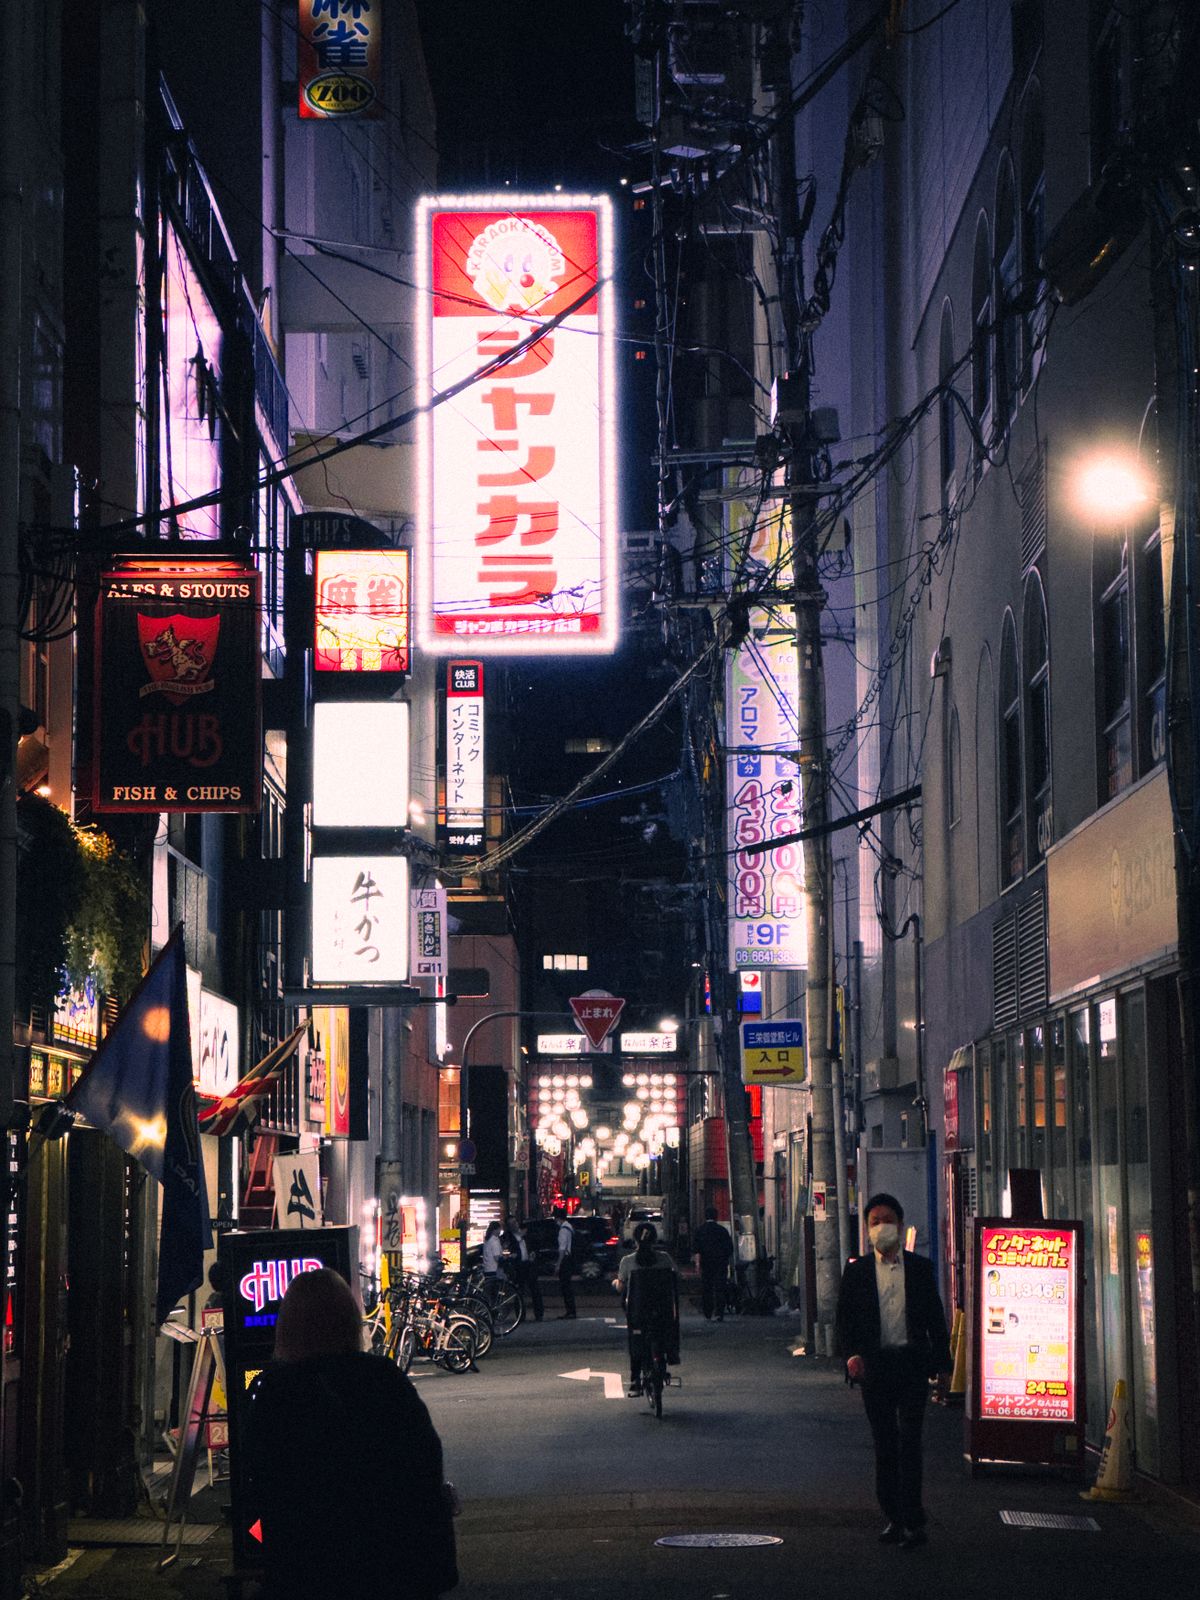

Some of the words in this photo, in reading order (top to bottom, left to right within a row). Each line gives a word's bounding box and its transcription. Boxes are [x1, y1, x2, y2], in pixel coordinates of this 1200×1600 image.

[471, 221, 529, 271] KARAOKE
[475, 324, 559, 607] ジャンカラ
[106, 583, 156, 599] ALES
[159, 583, 175, 599] &
[179, 583, 251, 599] STOUTS
[454, 669, 476, 680] 快活
[454, 680, 476, 689] CLUB
[740, 687, 758, 741] アロマ
[127, 712, 223, 768] HUB
[468, 704, 480, 762] コミック
[452, 703, 465, 803] インターネット
[112, 786, 157, 801] FISH
[163, 786, 178, 801] &
[186, 786, 242, 801] CHIPS
[465, 834, 483, 846] 4F
[349, 870, 385, 964] 牛かつ
[423, 912, 435, 956] あきんど
[756, 922, 791, 946] 9F
[581, 1006, 615, 1019] 止まれ
[759, 1049, 790, 1063] 入口
[212, 1220, 234, 1229] OPEN
[239, 1258, 324, 1313] HU
[984, 1395, 1037, 1407] アットワン
[997, 1408, 1068, 1418] 06-6647-5700
